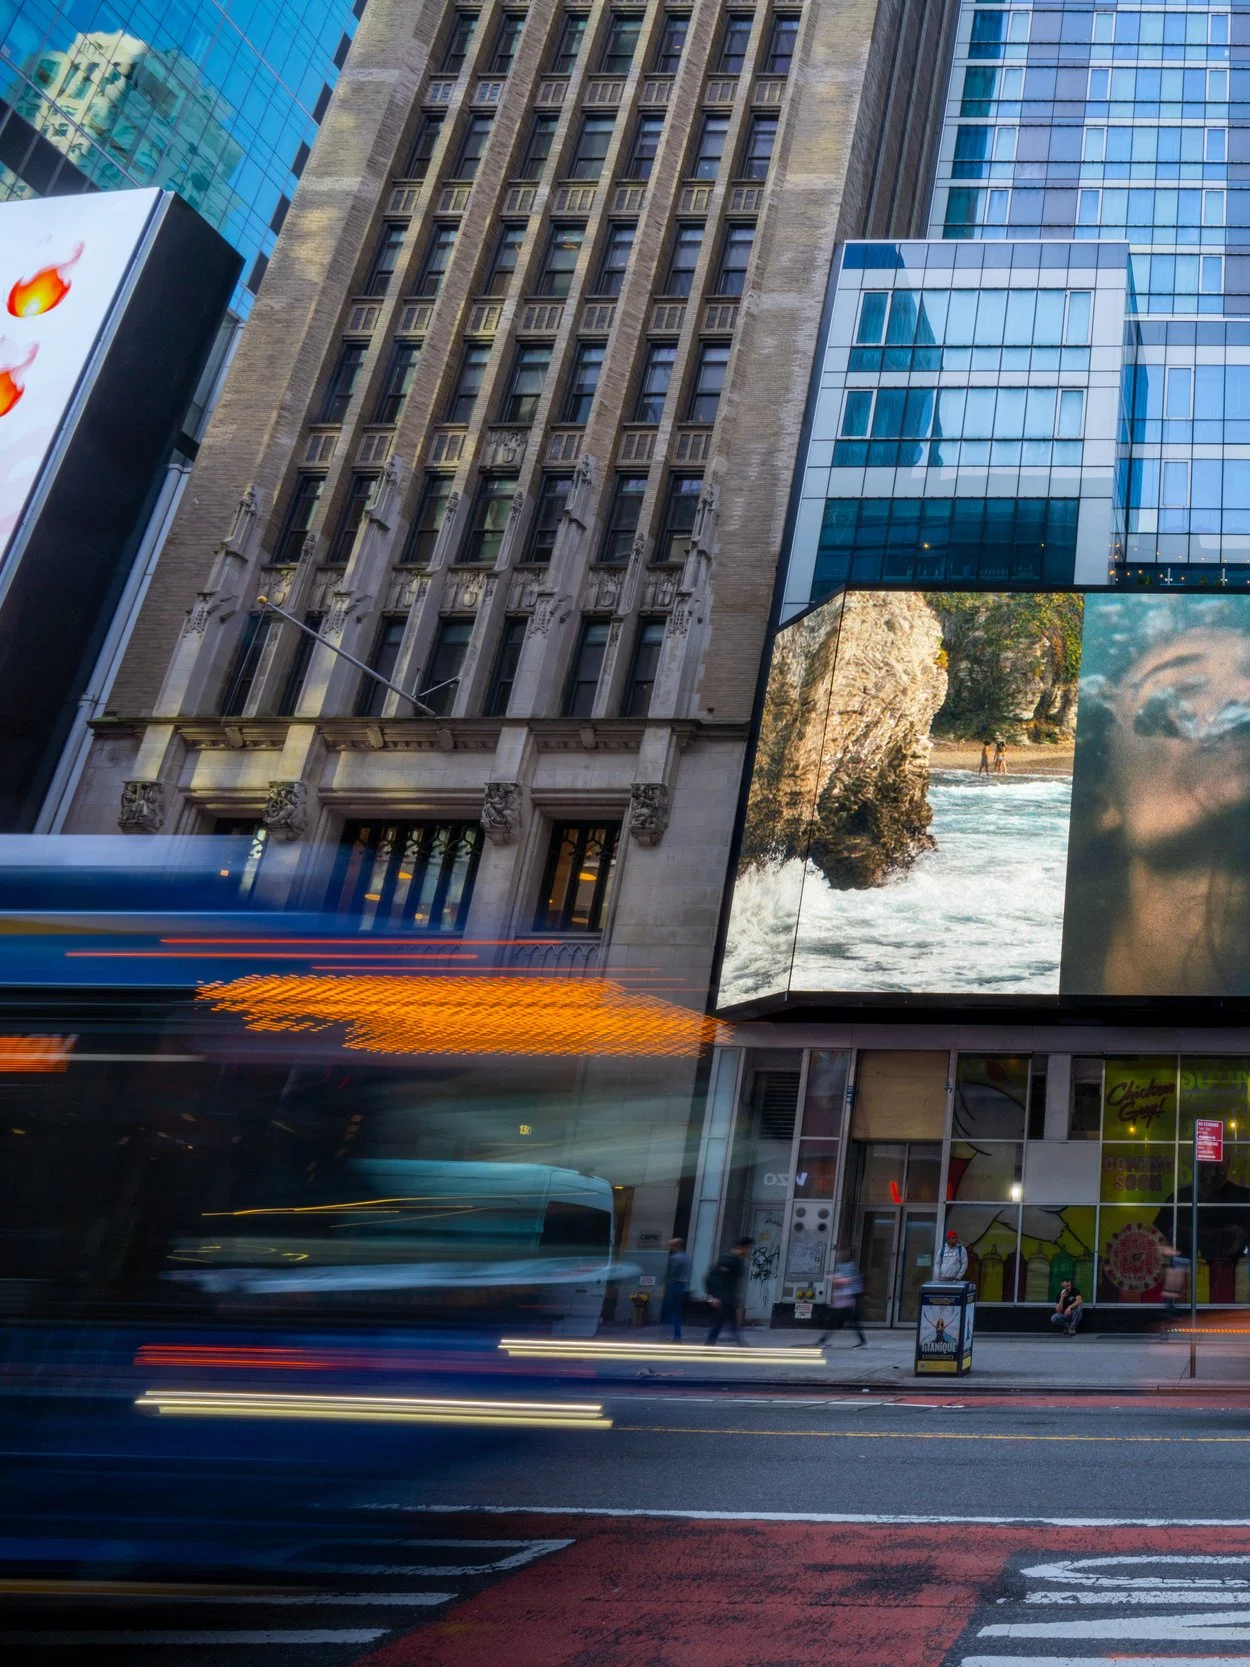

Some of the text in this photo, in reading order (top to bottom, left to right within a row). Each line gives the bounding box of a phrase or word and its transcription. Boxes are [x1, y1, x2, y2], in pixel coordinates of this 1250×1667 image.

[1106, 1078, 1176, 1106] Chicken
[1103, 1156, 1173, 1172] COMING
[1113, 1174, 1161, 1191] SOON
